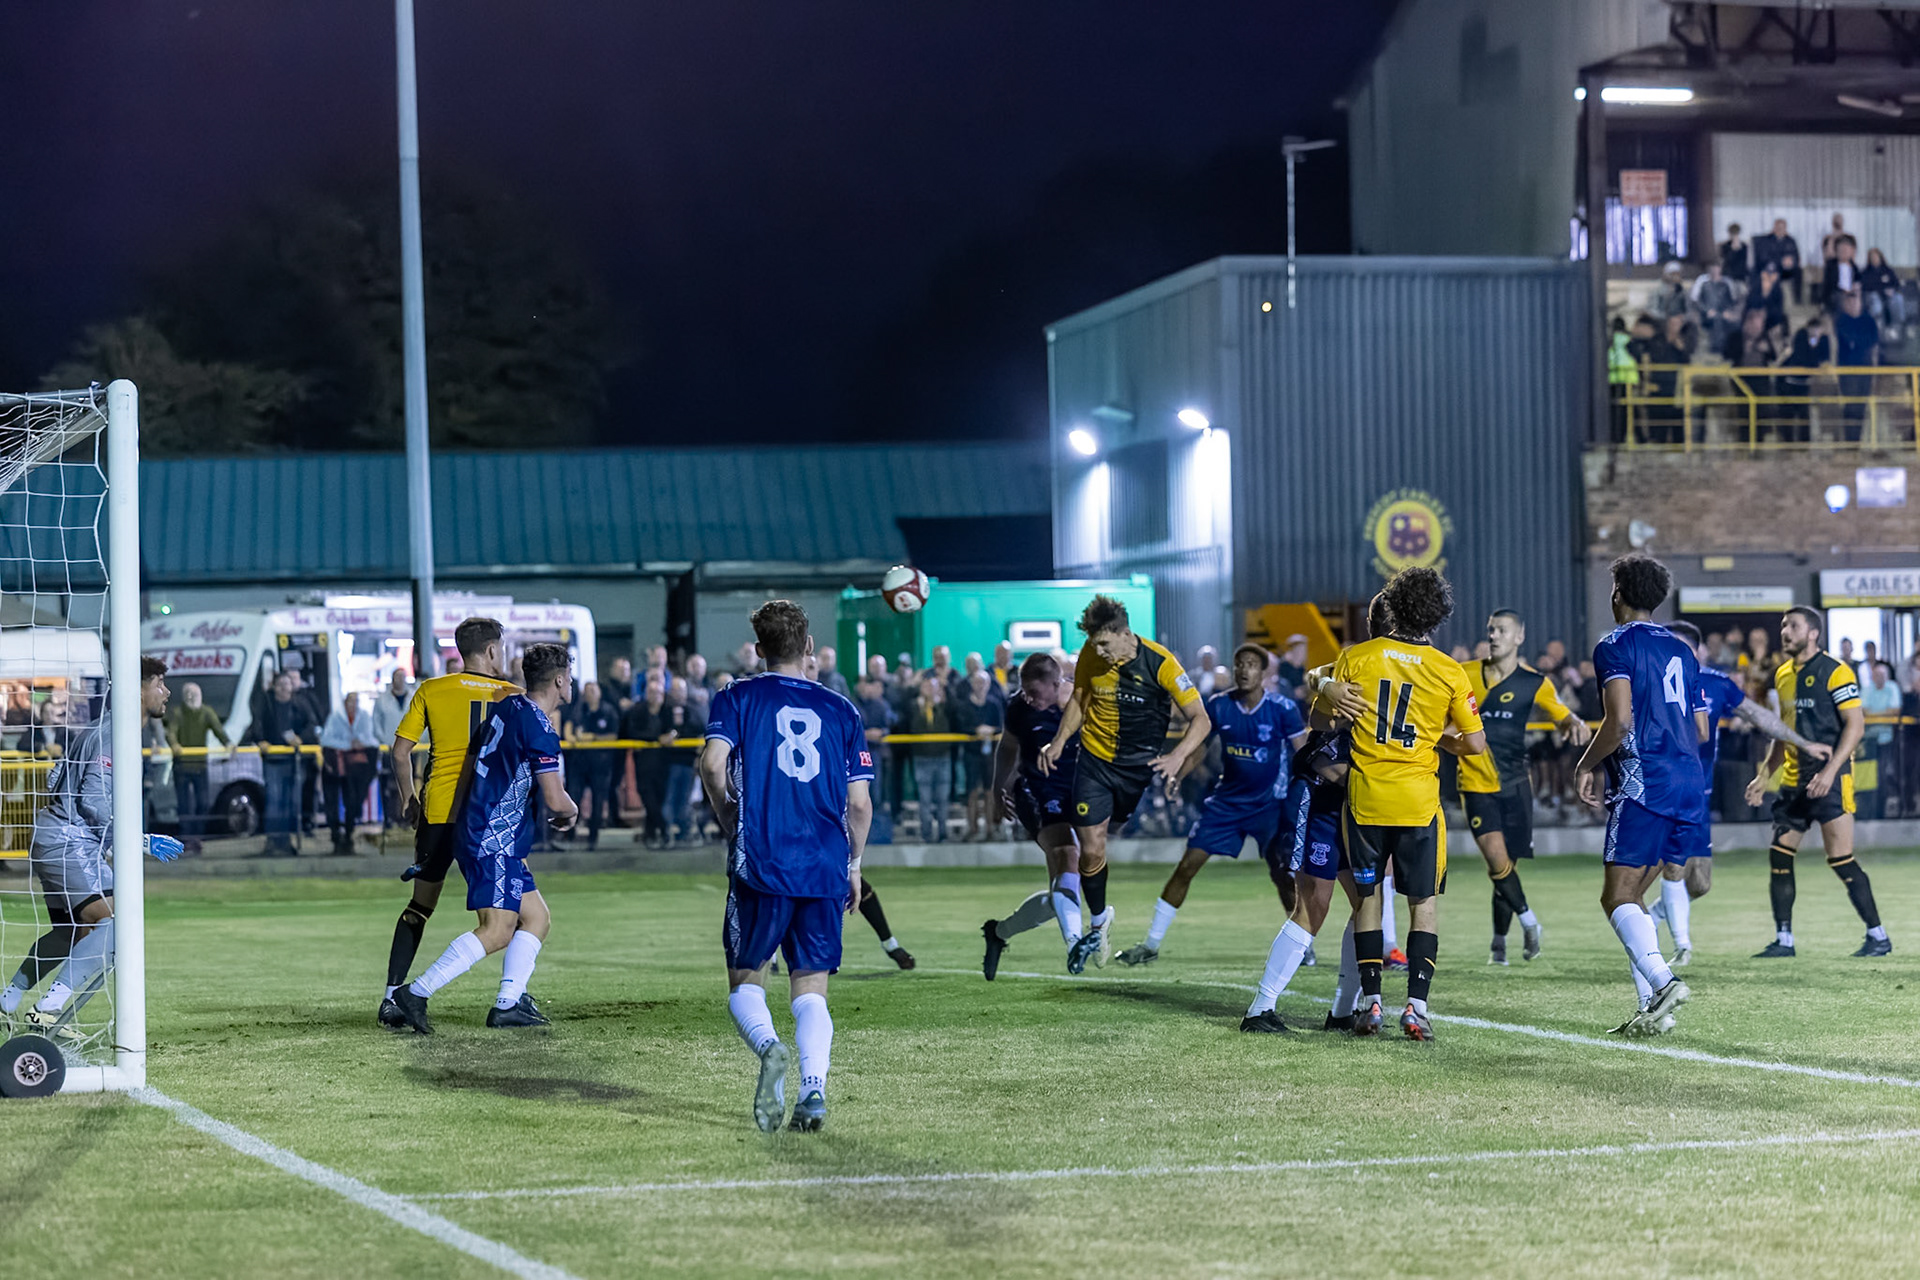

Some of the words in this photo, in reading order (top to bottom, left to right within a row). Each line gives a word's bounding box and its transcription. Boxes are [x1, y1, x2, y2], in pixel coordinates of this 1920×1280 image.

[1844, 574, 1914, 592] CABLES
[170, 650, 235, 670] Snacks
[190, 619, 244, 644] Coffee
[1375, 678, 1418, 748] 14
[1663, 656, 1686, 718] 4
[475, 714, 505, 778] 2
[775, 705, 822, 783] 8
